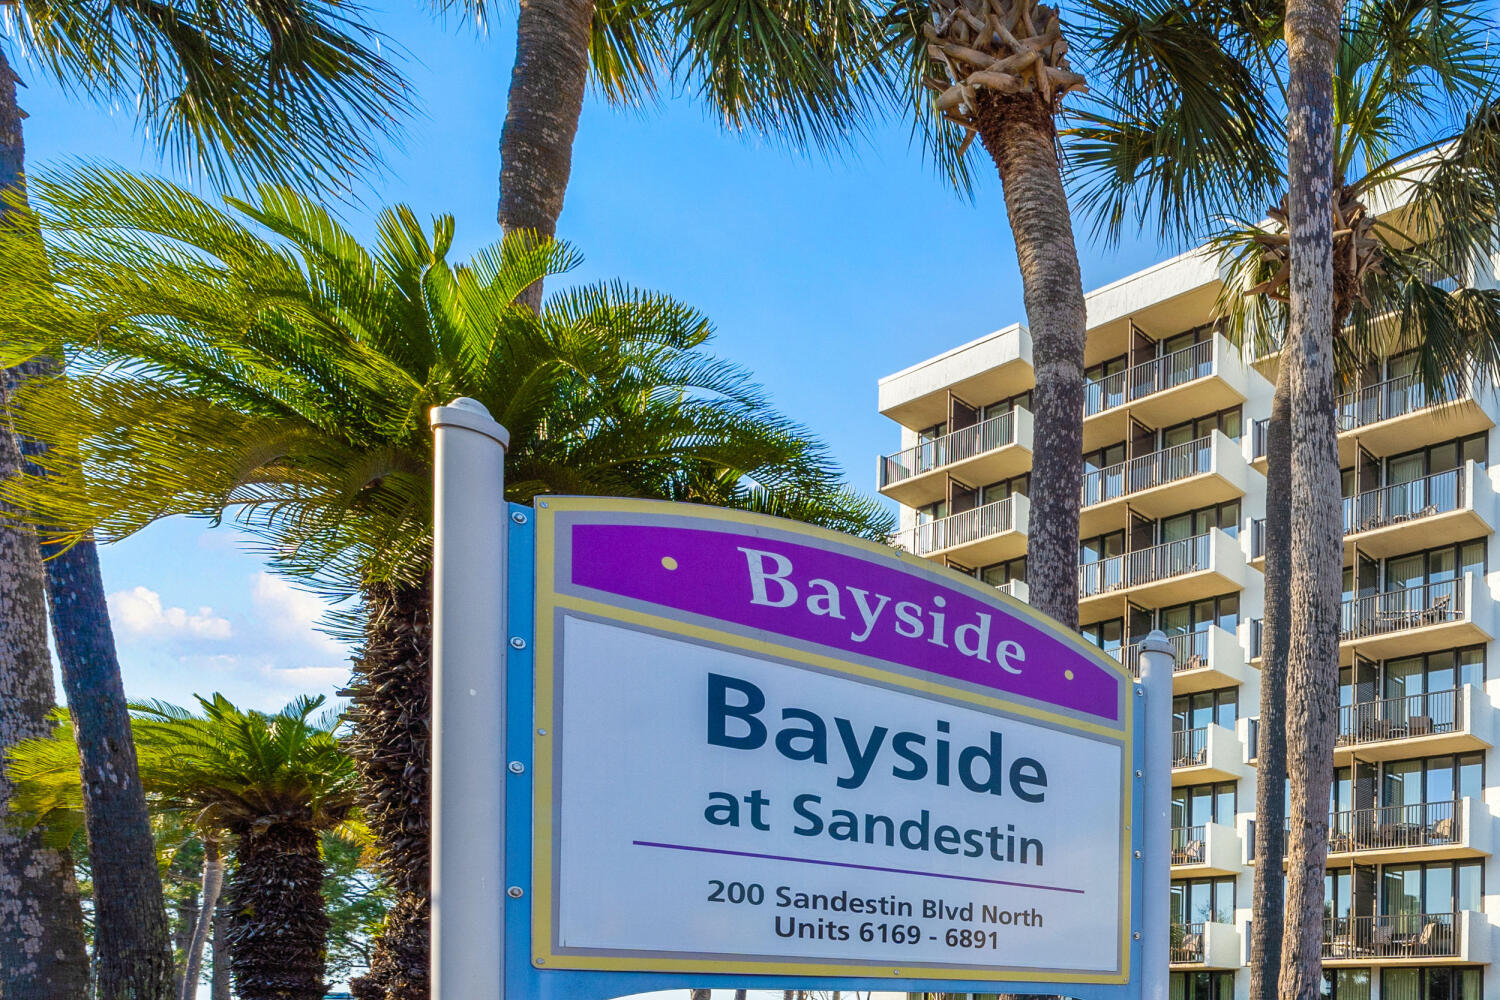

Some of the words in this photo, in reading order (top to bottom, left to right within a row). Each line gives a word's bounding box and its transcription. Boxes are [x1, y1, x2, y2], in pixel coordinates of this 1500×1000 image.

[736, 546, 1026, 675] Bayside
[707, 672, 1047, 803] Bayside
[703, 789, 771, 832] at
[792, 792, 1043, 866] Sandestin
[707, 879, 765, 906] 200
[775, 885, 912, 916] Sandestin
[922, 898, 974, 923] Blvd
[981, 904, 1043, 928] North
[774, 915, 850, 942] Units
[859, 921, 921, 946] 6169
[944, 928, 998, 950] 6891
